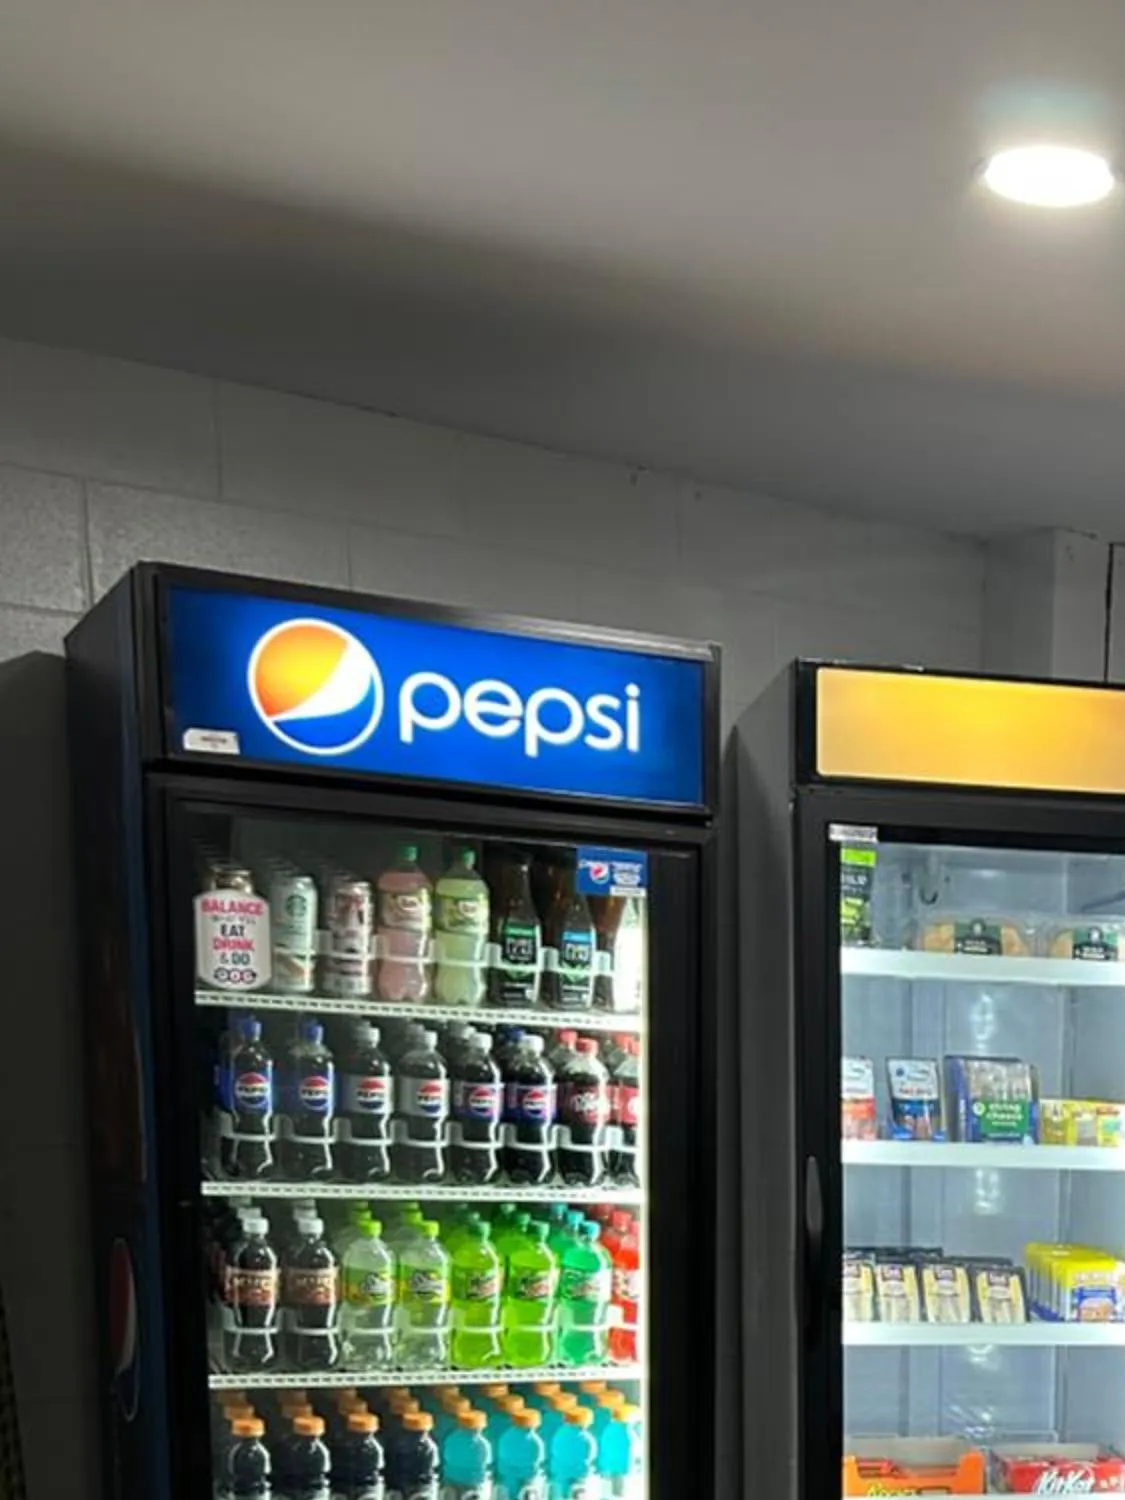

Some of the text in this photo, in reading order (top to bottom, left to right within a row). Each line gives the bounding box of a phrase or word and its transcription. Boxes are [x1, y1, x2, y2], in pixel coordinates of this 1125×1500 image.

[399, 671, 641, 757] pepsi
[201, 898, 264, 916] BALANCE
[220, 924, 245, 937] EAT
